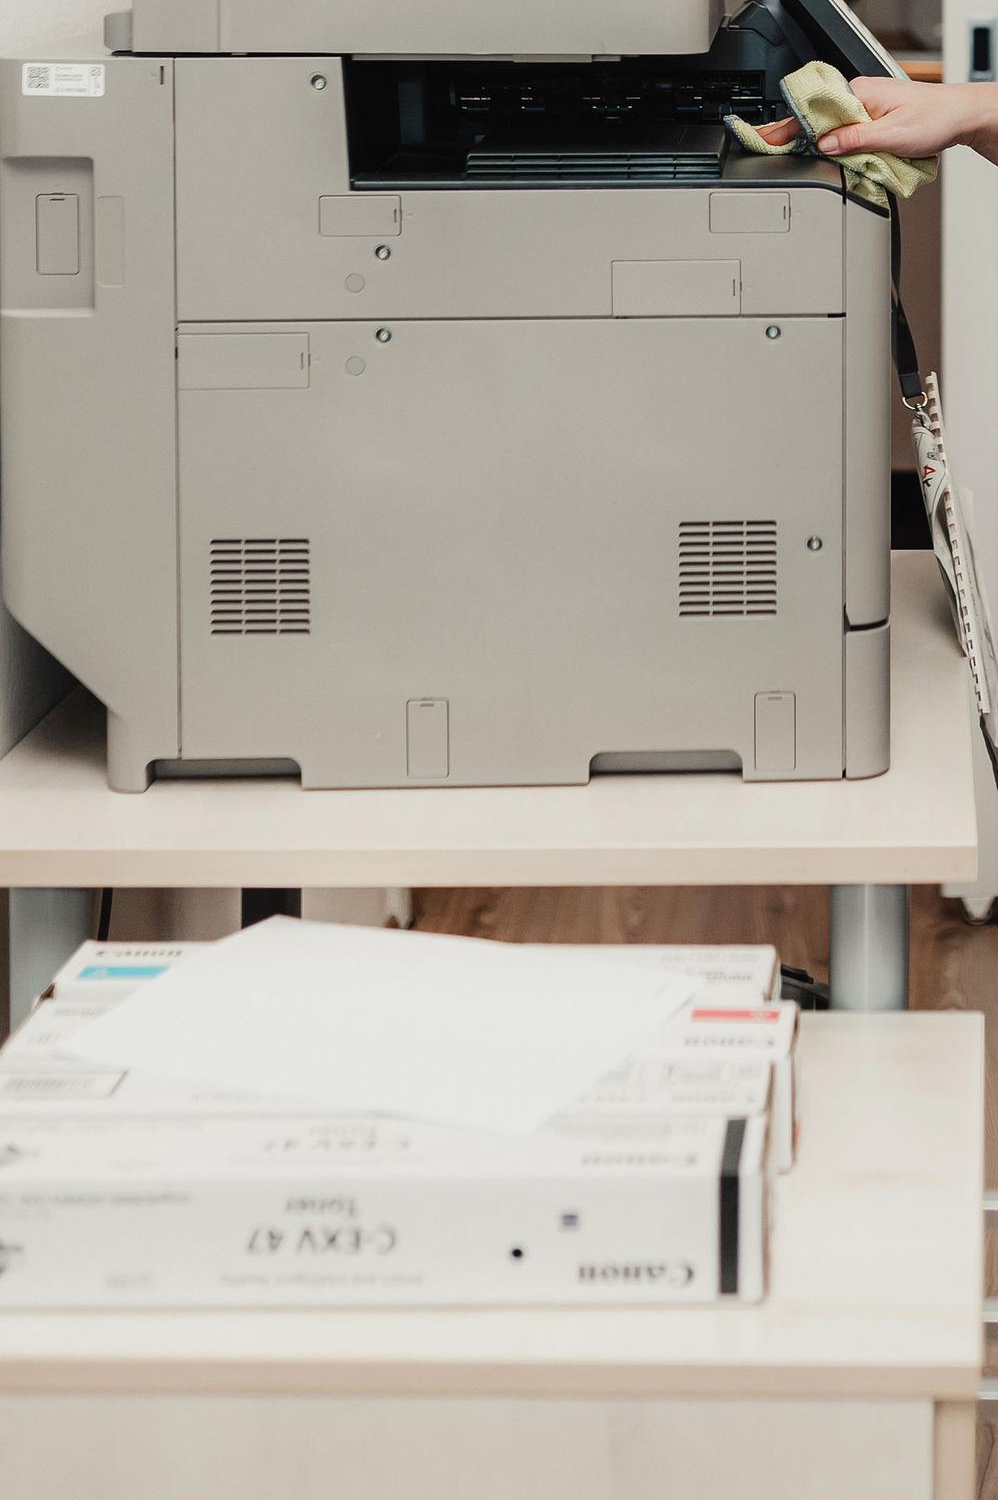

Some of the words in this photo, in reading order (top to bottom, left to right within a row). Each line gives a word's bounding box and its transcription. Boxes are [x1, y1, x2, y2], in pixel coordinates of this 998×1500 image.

[245, 1228, 286, 1256] 47
[296, 1224, 397, 1256] C-EXV
[577, 1260, 695, 1288] Canon
